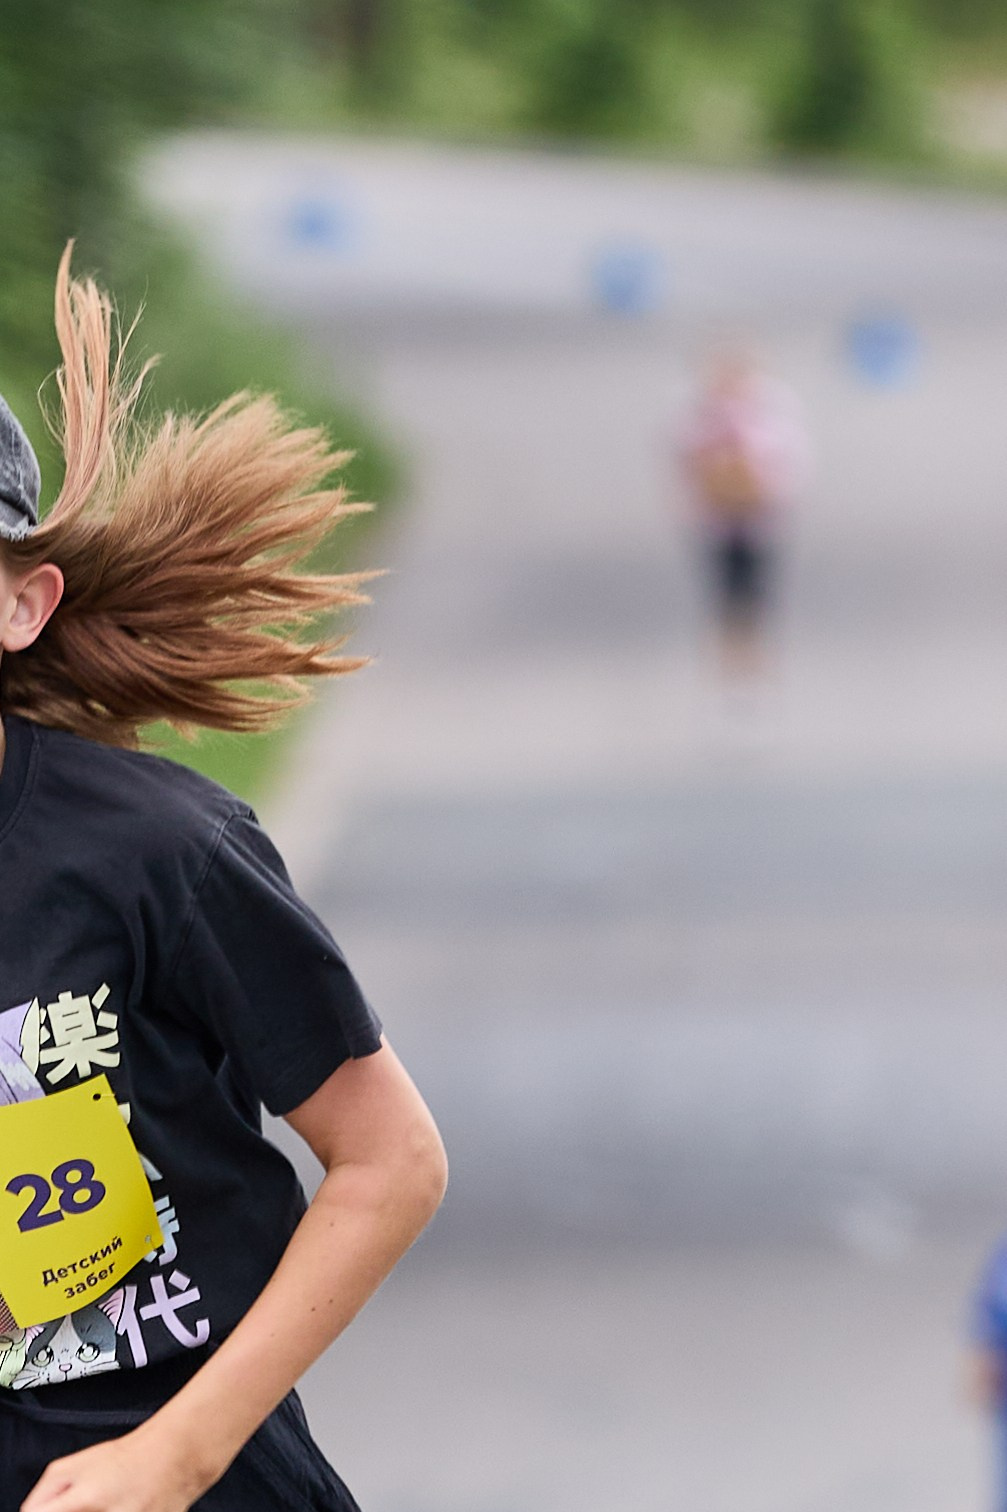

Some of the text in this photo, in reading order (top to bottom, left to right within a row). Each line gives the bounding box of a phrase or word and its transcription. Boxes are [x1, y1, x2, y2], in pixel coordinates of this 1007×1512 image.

[5, 1159, 106, 1233] 28
[42, 1236, 123, 1287] Детский
[64, 1262, 118, 1299] забег
